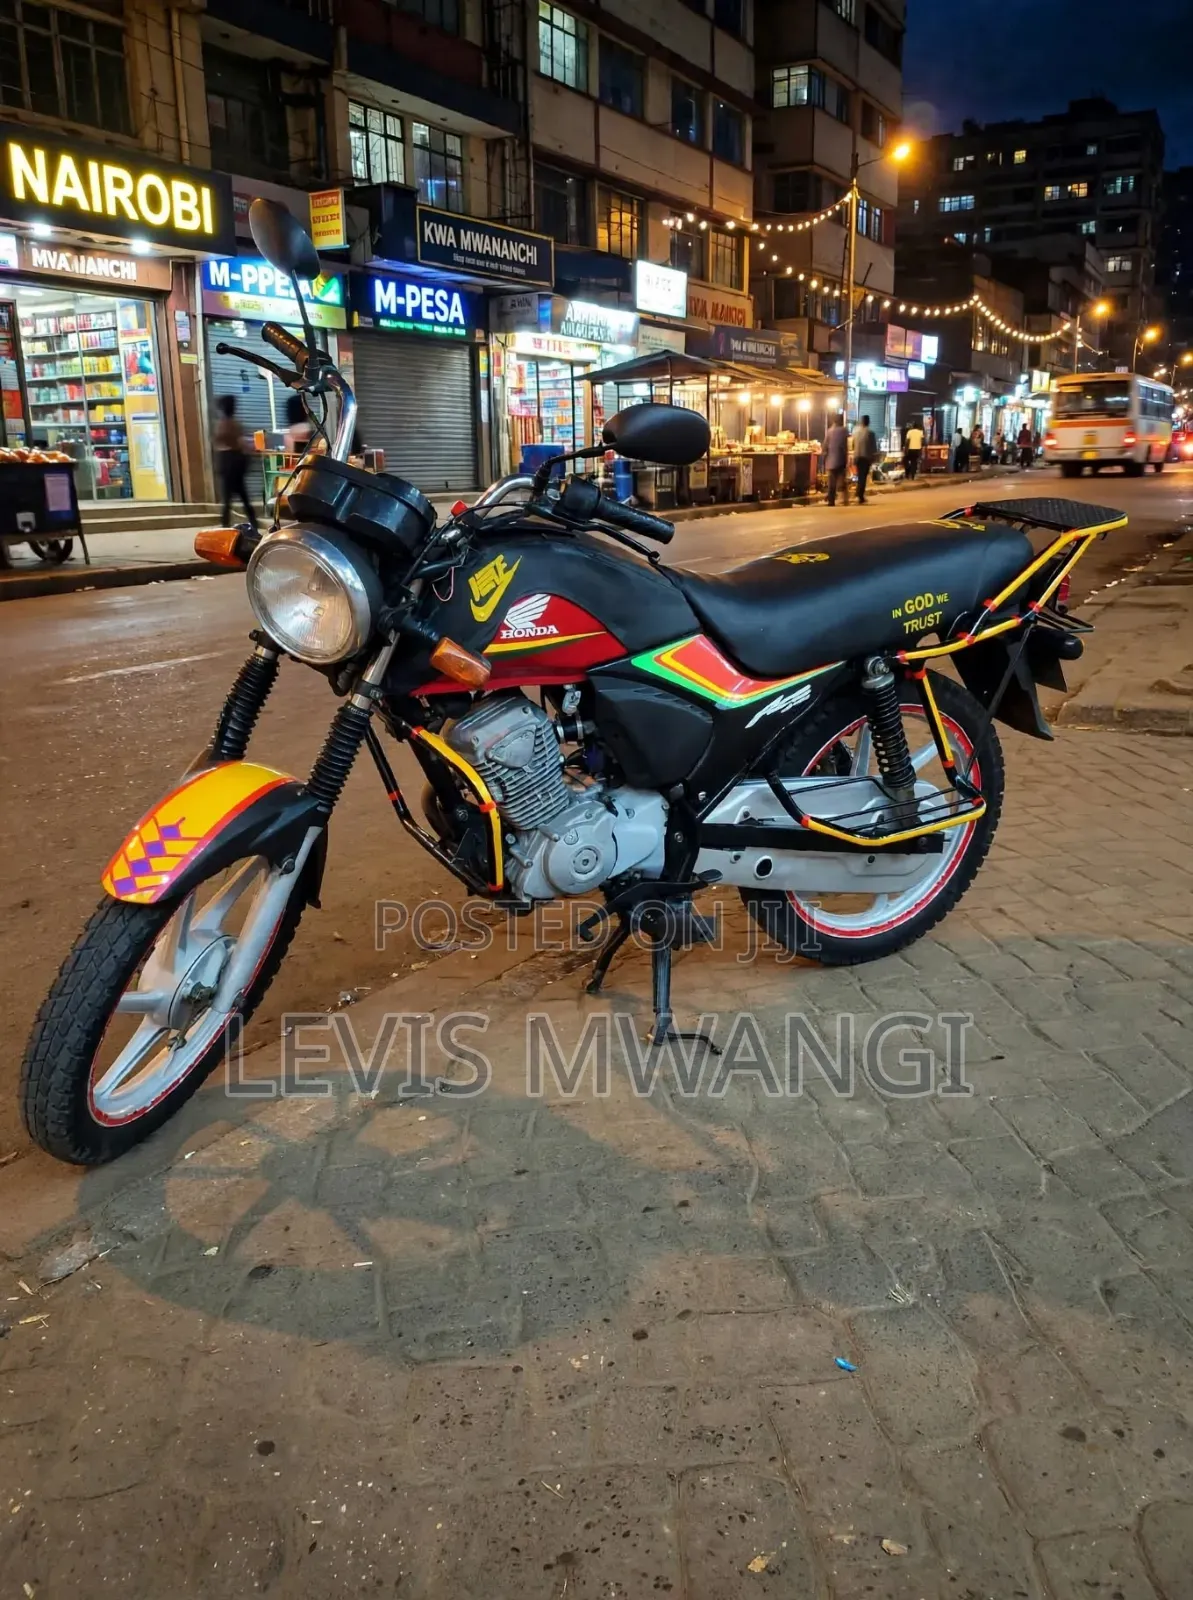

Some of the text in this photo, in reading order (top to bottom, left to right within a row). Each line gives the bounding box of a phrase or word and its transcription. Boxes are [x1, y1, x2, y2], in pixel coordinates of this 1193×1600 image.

[9, 142, 213, 234] NAIROBI
[424, 220, 457, 249] KWA
[460, 228, 538, 266] MWANANCHI
[209, 260, 315, 300] M-PPEA
[374, 279, 465, 325] M-PESA
[892, 592, 949, 618] IN GOD WE
[903, 611, 942, 634] TRUST
[500, 625, 560, 639] HONDA
